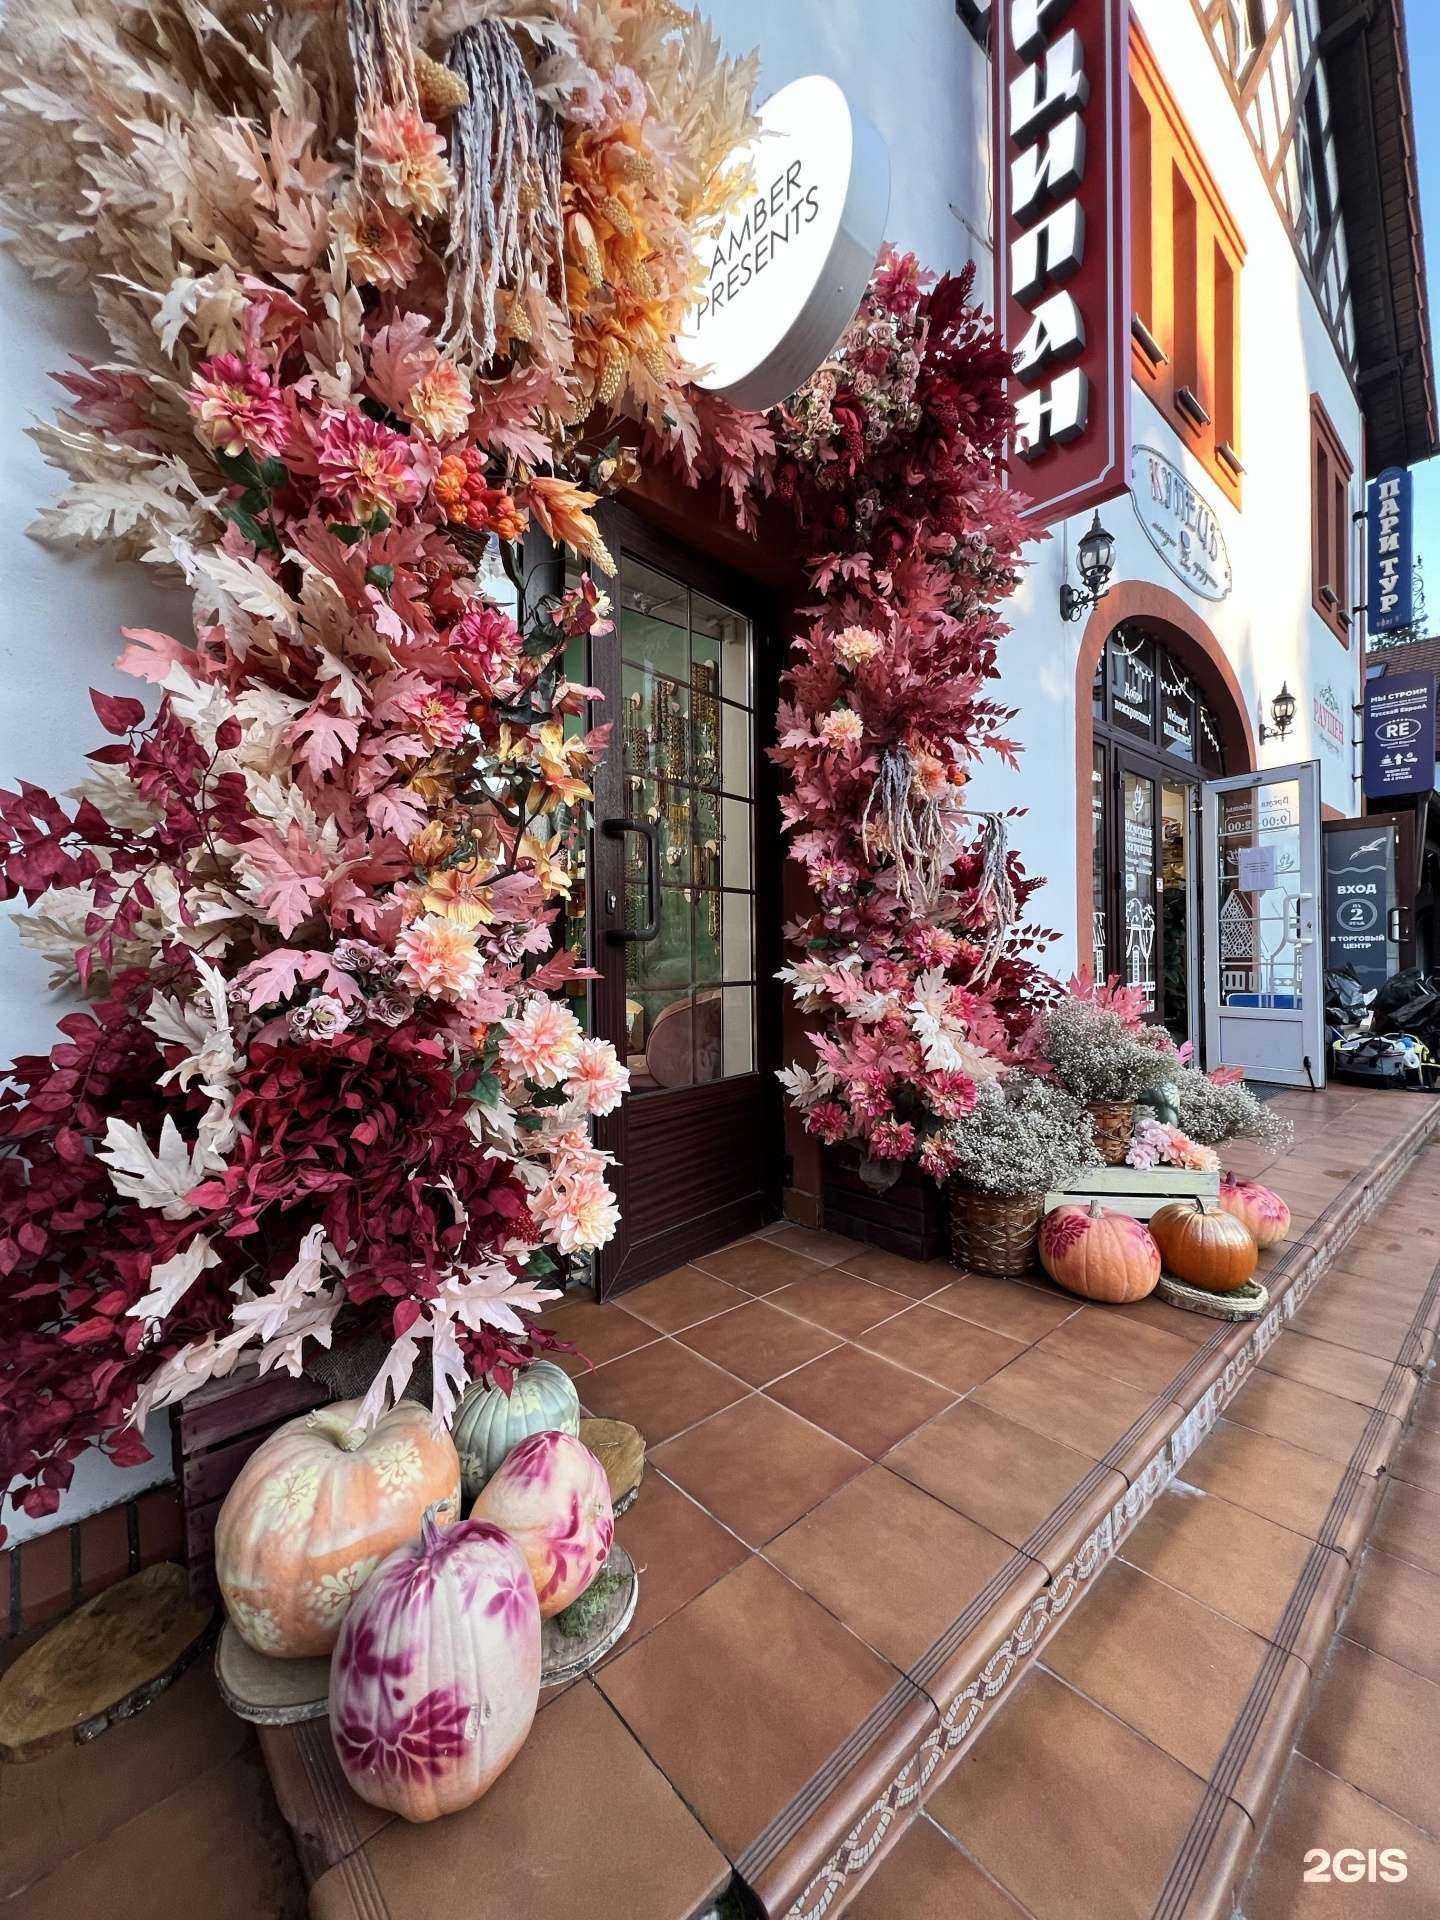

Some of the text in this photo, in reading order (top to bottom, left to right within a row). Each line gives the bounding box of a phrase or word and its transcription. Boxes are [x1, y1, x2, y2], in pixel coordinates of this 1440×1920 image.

[709, 159, 802, 281] AMBER
[696, 185, 819, 331] PRESENTS
[1386, 722, 1410, 738] RE
[1337, 883, 1377, 895] ВХОД
[1350, 908, 1364, 921] 2
[1337, 934, 1385, 942] ТОРГОВЫЙ
[1343, 942, 1372, 950] ЦЕНТР
